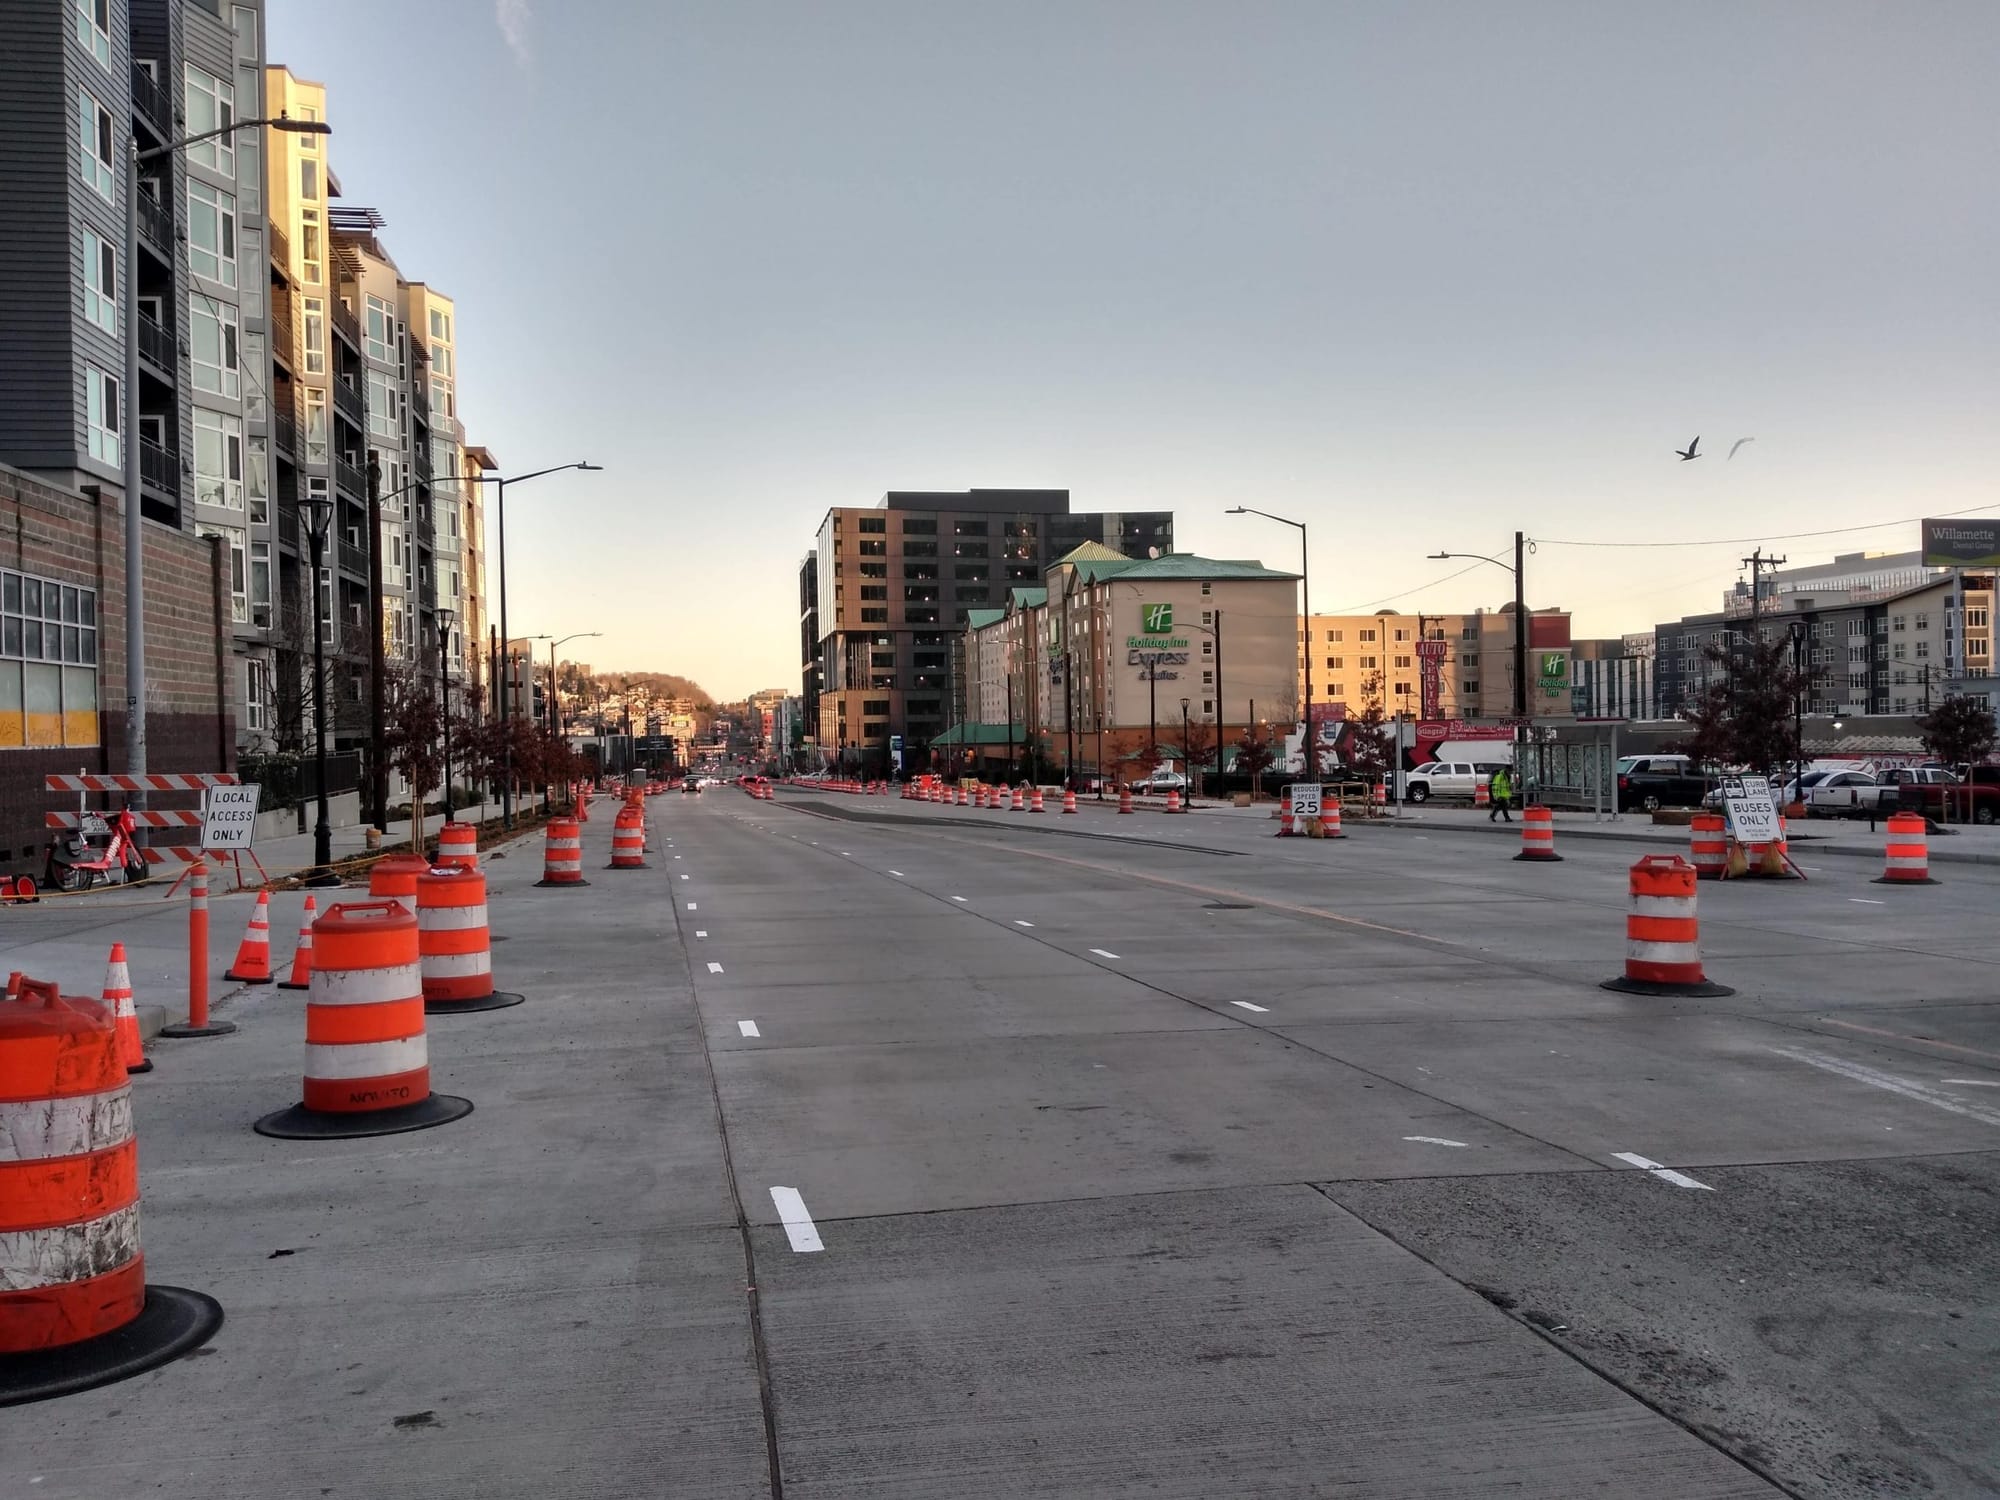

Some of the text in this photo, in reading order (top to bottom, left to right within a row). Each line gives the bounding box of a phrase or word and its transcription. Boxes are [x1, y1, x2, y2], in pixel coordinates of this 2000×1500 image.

[1931, 527, 1995, 540] Willamette
[1126, 636, 1188, 650] Holiday Inn
[1417, 642, 1446, 655] AUTO
[1127, 649, 1189, 669] Express
[1538, 679, 1570, 690] Holiday
[1546, 688, 1562, 697] Inn
[1293, 785, 1320, 793] REDUCED
[1744, 780, 1766, 788] CURB
[215, 792, 253, 804] LOCAL
[1747, 788, 1769, 796] LANE
[1294, 801, 1318, 814] 25
[1733, 802, 1772, 813] BUSES
[209, 810, 253, 822] ACCESS
[1739, 815, 1770, 826] ONLY
[212, 829, 244, 842] ONLY
